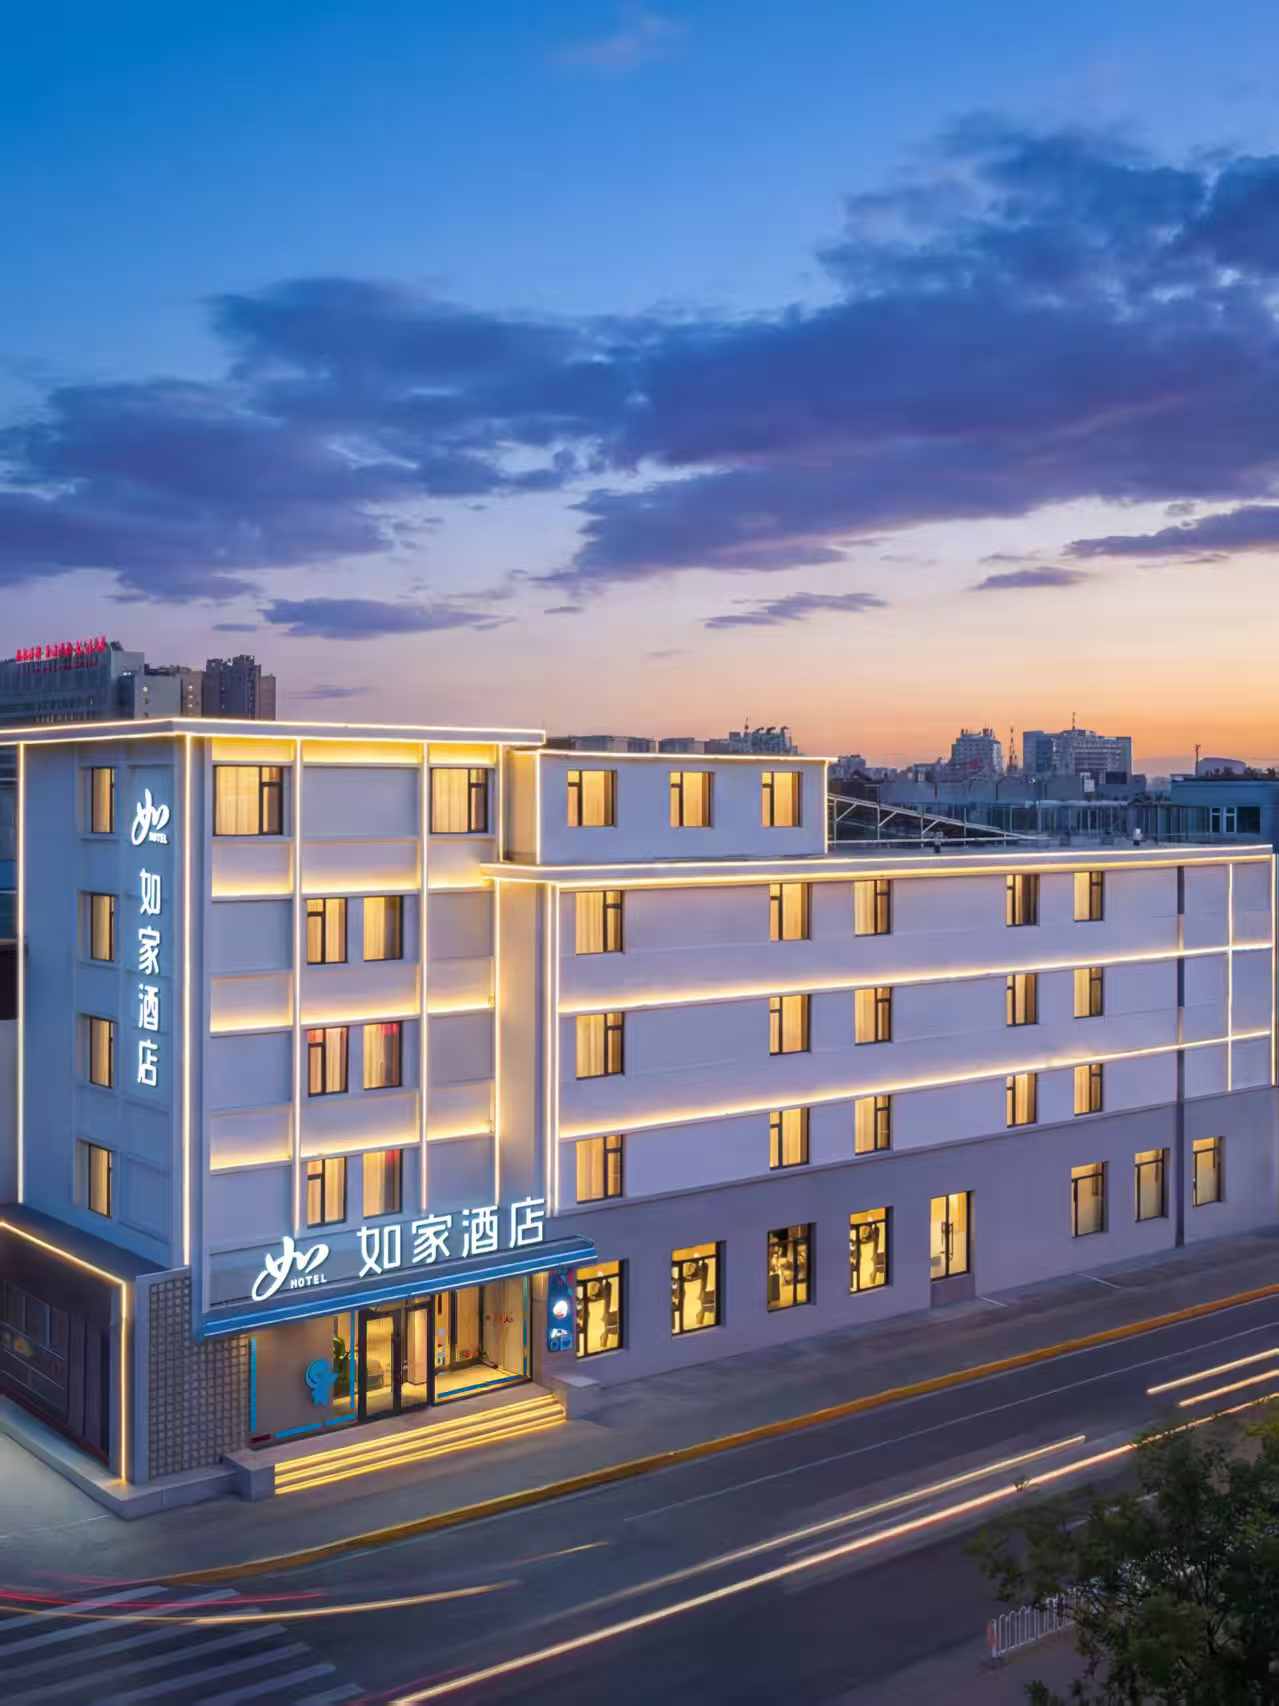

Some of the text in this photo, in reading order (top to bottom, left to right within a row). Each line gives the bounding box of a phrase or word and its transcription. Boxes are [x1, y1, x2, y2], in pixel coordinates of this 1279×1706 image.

[137, 868, 161, 1086] 如家酒店
[356, 1196, 545, 1278] 如家酒店
[290, 1274, 327, 1289] HOTEL
